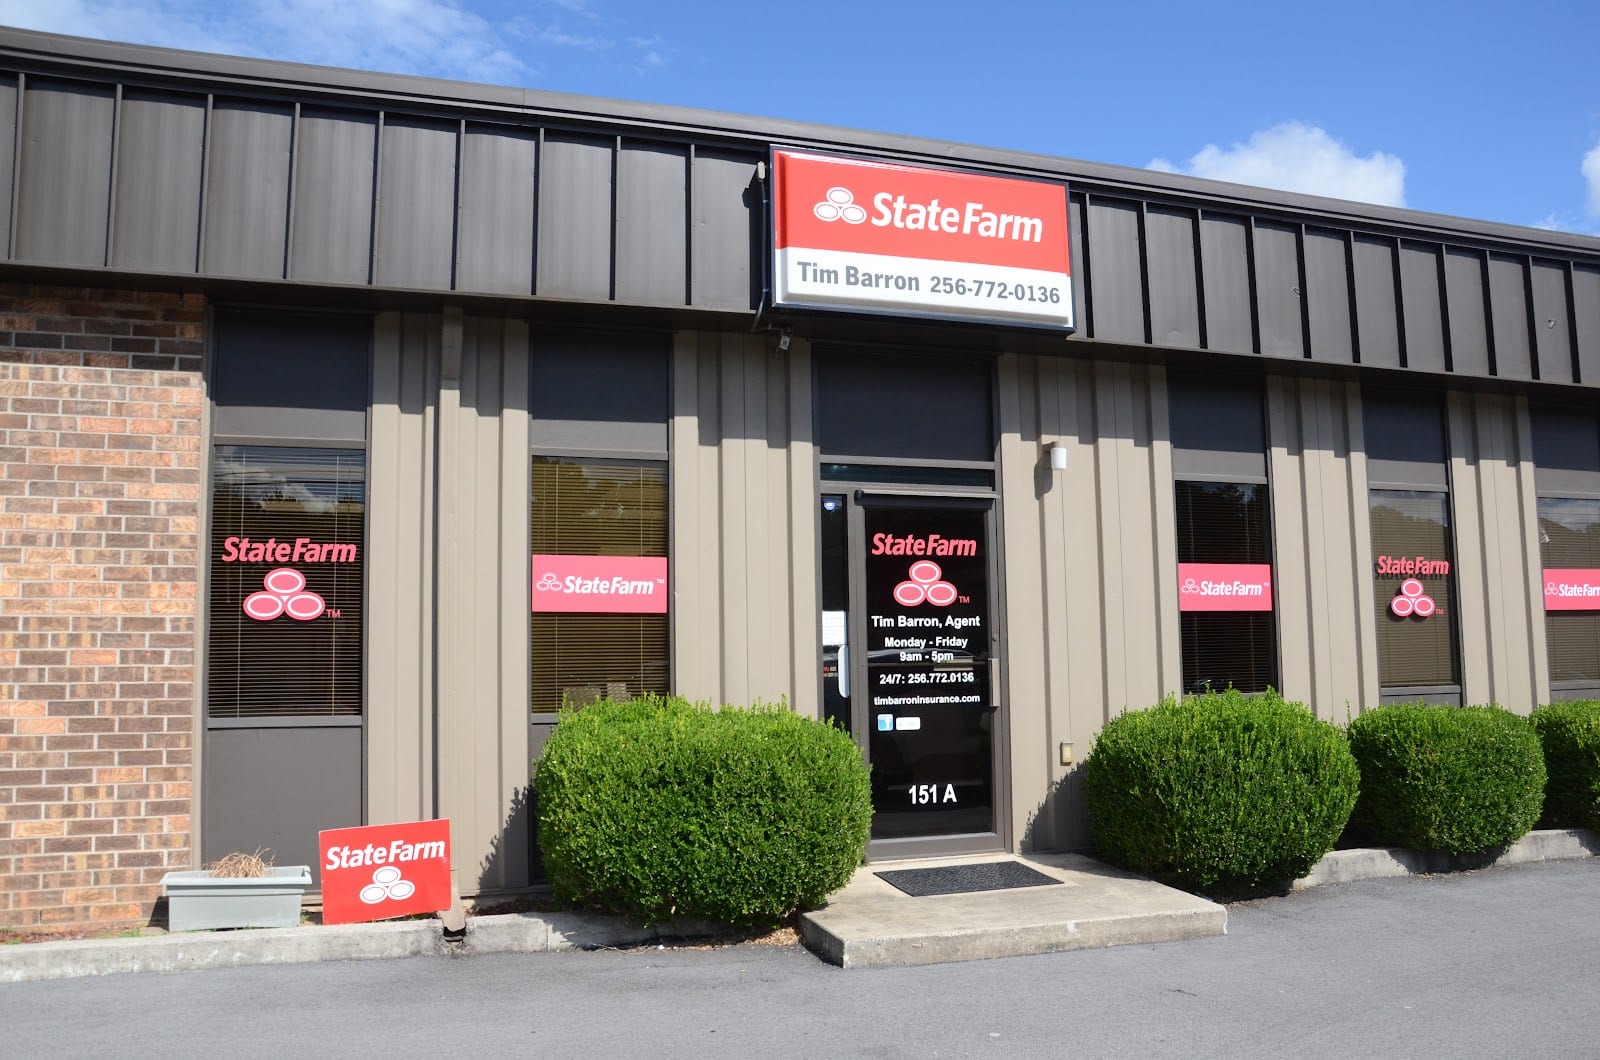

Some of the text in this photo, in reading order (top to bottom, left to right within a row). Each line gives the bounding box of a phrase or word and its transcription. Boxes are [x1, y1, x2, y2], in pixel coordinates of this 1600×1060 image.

[797, 261, 1061, 304] Tim Barron 256-772-0136
[871, 615, 981, 629] Tim Barron, Agent
[884, 636, 926, 649] Monday
[936, 636, 968, 649] Friday
[900, 651, 922, 662] 9am
[931, 651, 954, 663] 5pm
[880, 672, 975, 685] 24/7: 256.772.0136
[874, 694, 981, 706] timbarroninsurance.com
[908, 783, 958, 805] 151 A
